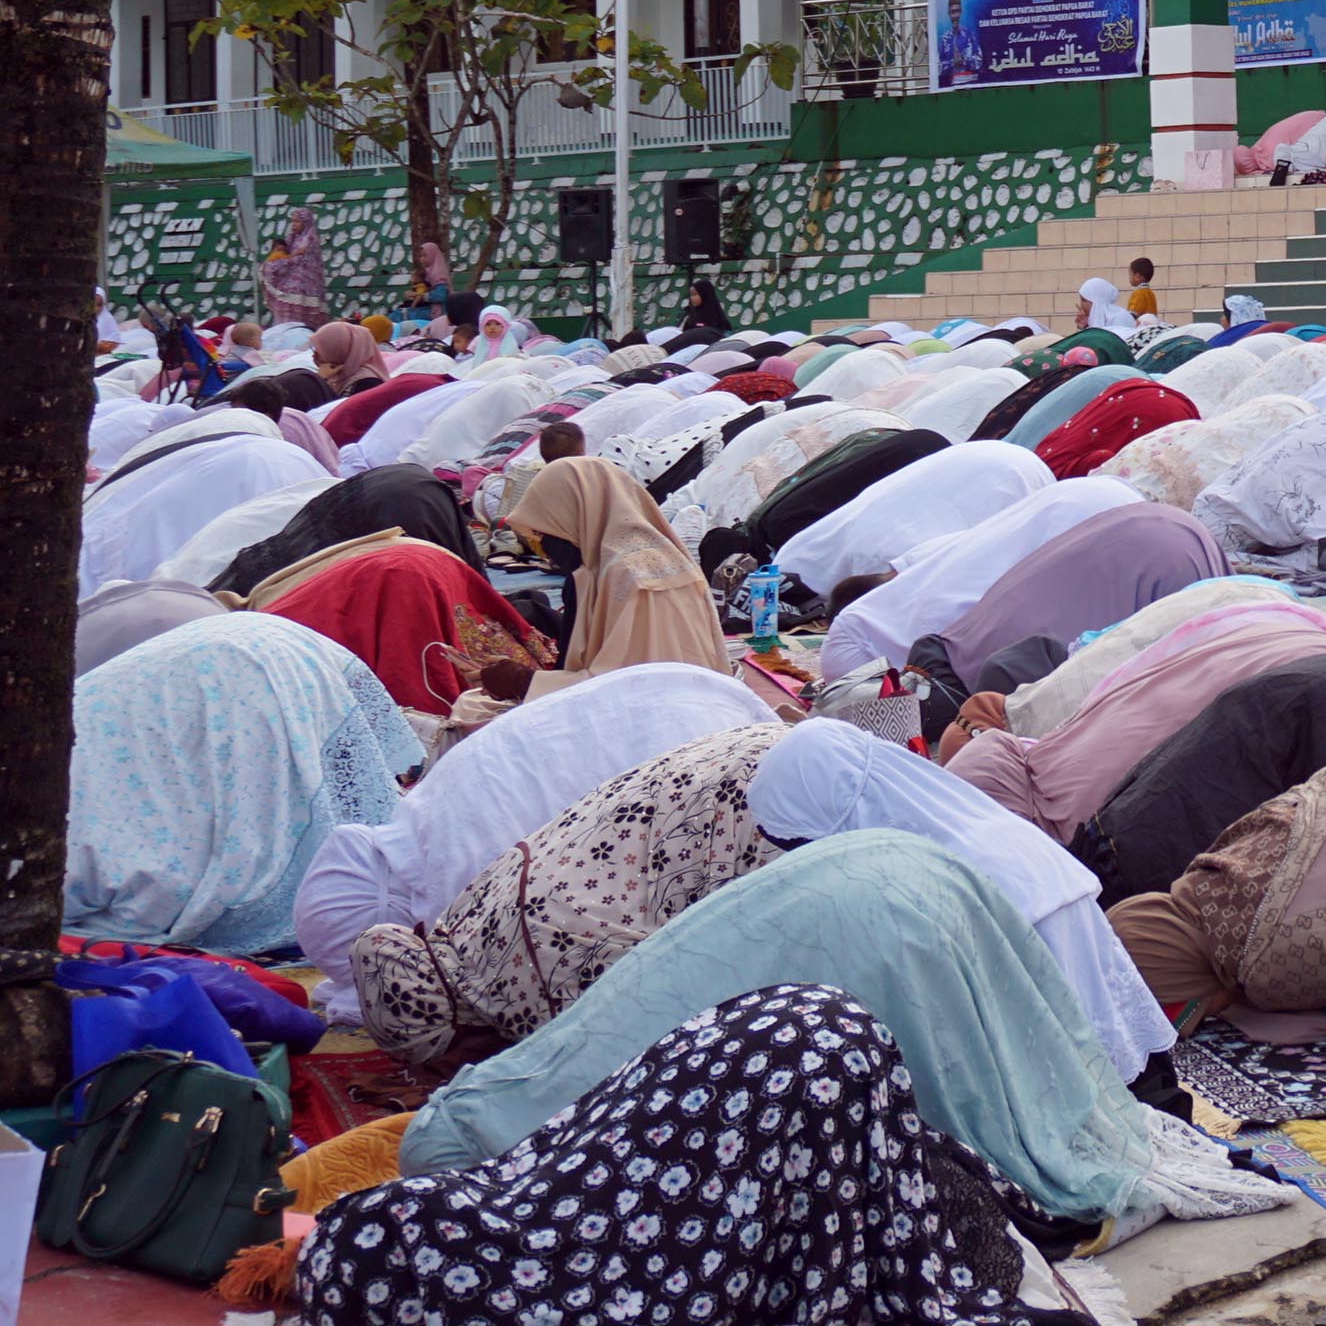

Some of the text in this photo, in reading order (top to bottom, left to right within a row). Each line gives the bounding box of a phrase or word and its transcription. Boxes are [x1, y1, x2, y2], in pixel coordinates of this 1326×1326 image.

[1035, 3, 1061, 13] DEMOKRAT
[1061, 2, 1078, 11] PAPUA
[1078, 1, 1095, 9] BARAT
[1048, 13, 1075, 22] DEMOKRAT
[1075, 11, 1092, 20] PAPUA
[1092, 9, 1109, 18] BARAT
[1008, 29, 1078, 44] Selamat Hari Raya
[1040, 43, 1100, 66] adha
